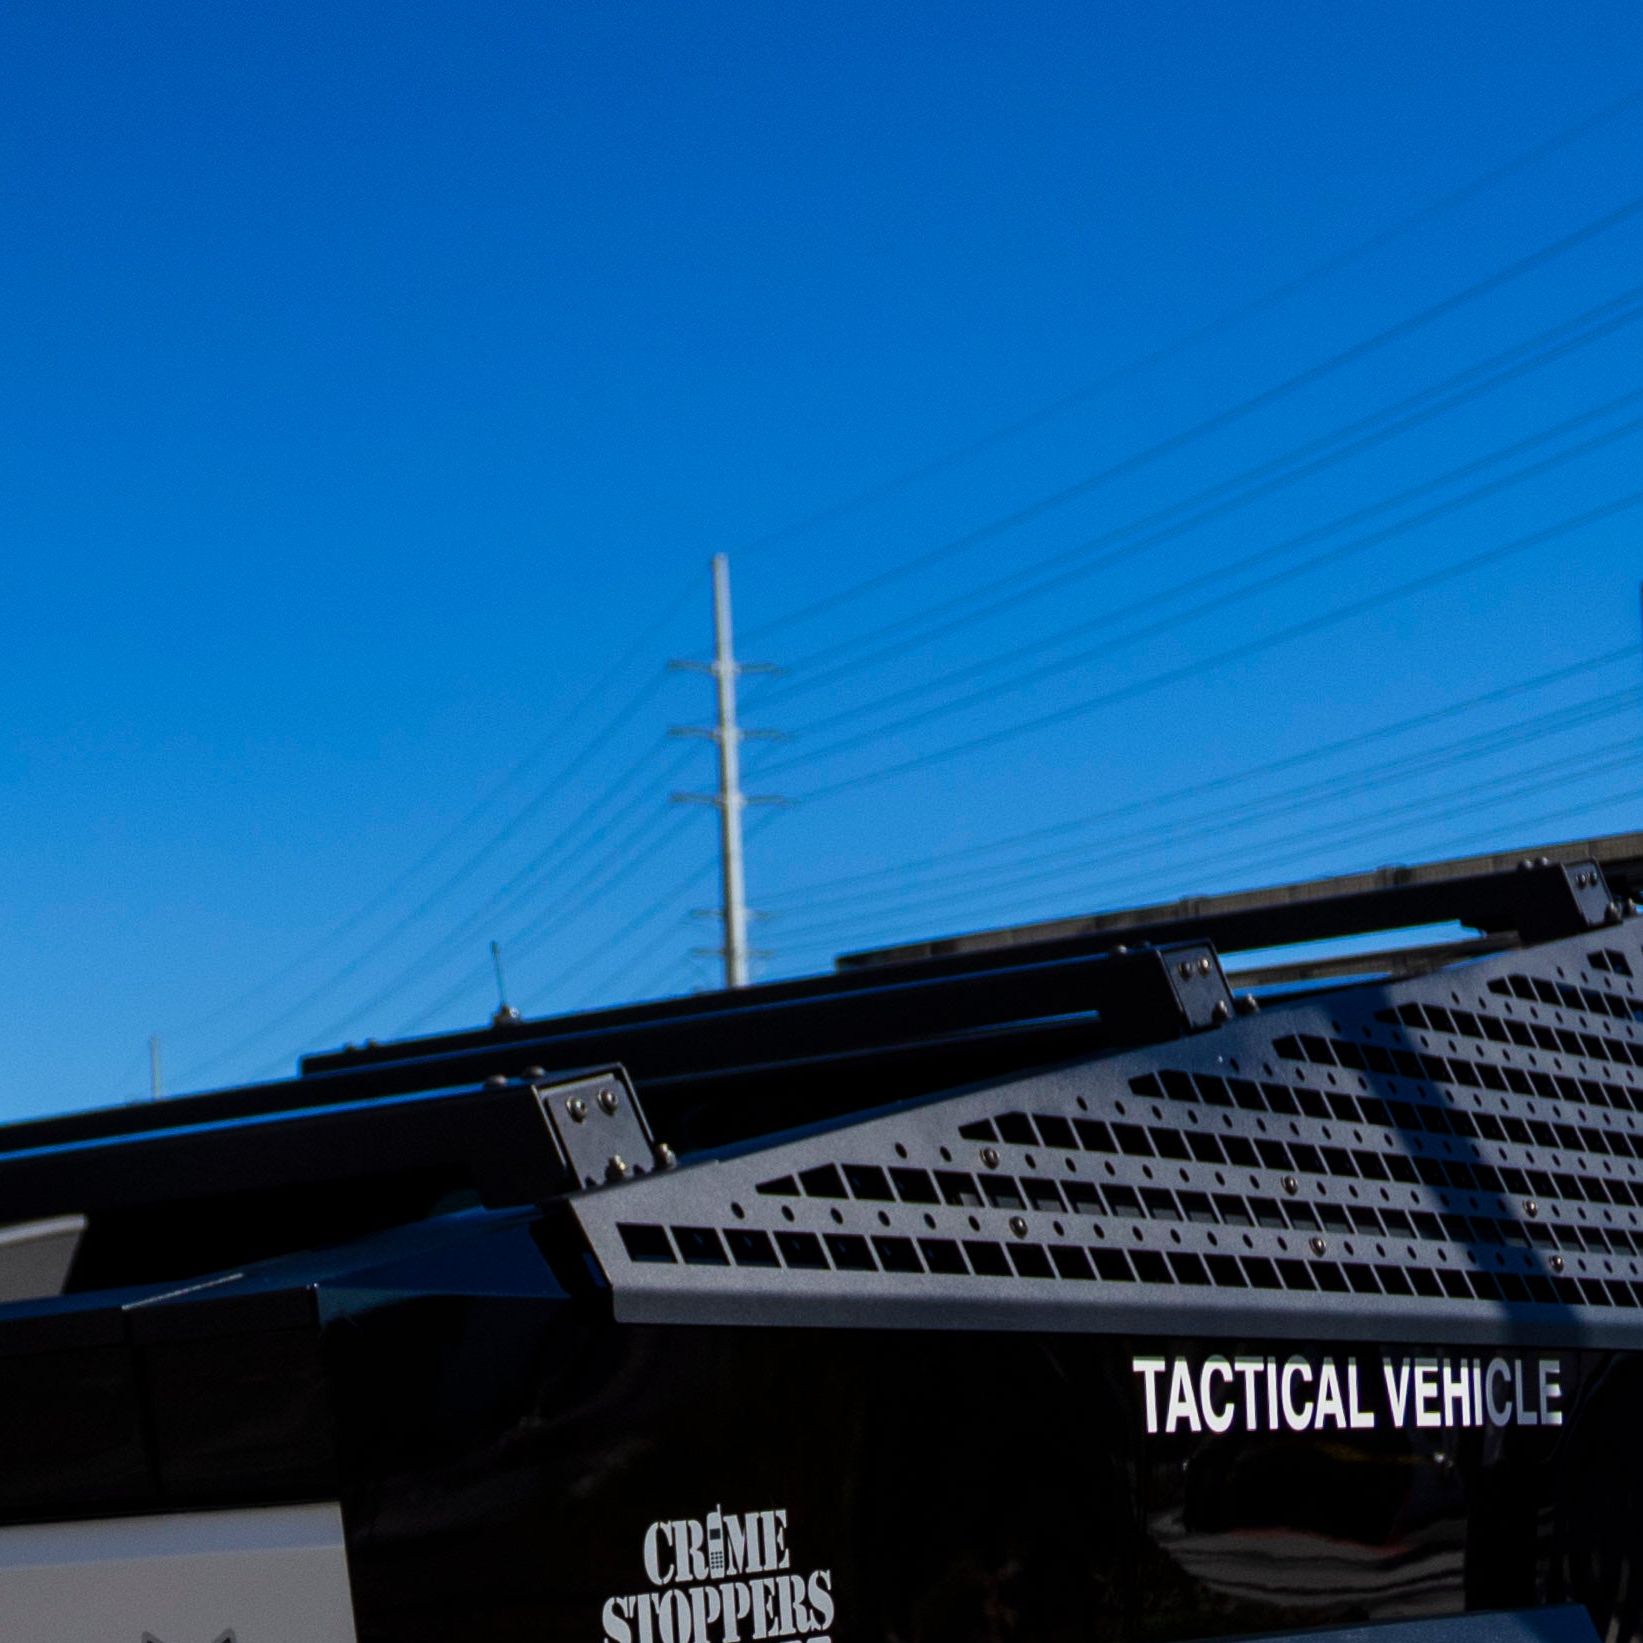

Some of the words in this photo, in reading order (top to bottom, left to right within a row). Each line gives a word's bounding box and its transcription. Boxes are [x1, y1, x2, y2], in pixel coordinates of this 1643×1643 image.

[1133, 1354, 1375, 1434] TACTICAL
[1383, 1356, 1563, 1428] VEHICLE
[643, 1503, 790, 1586] CRIME
